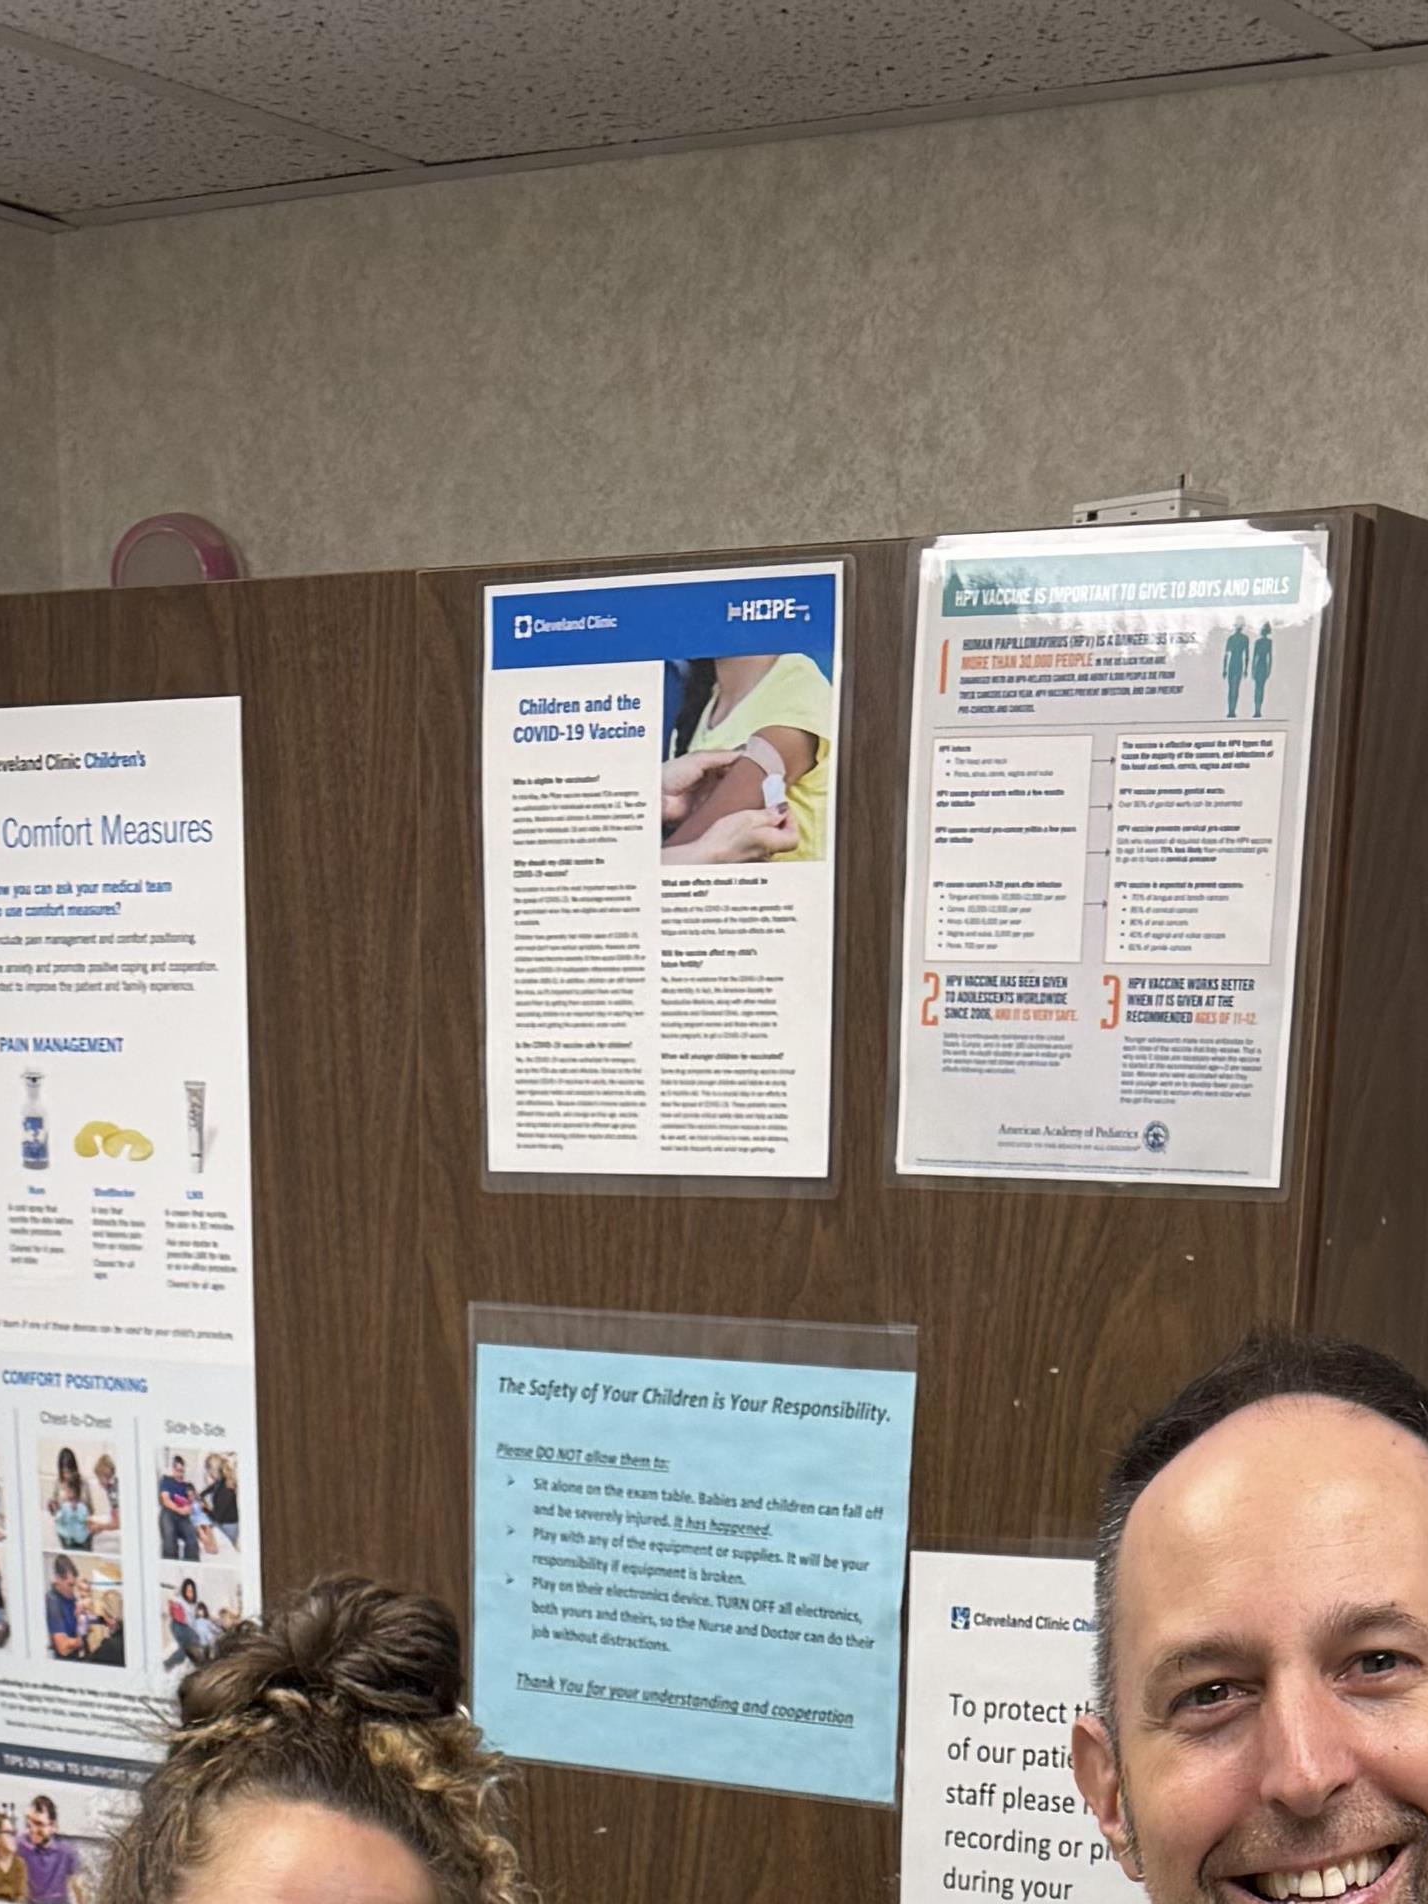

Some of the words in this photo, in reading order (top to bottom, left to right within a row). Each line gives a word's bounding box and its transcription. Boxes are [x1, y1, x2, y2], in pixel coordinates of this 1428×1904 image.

[954, 588, 980, 606] HPV
[981, 587, 1031, 605] VACCINE
[1033, 587, 1046, 604] IS
[1049, 584, 1117, 603] IMPORTANT
[1121, 583, 1135, 600] TO
[1138, 582, 1167, 599] GIVE
[1170, 581, 1185, 598] TO
[1188, 580, 1220, 597] BOYS
[1223, 578, 1249, 595] AND
[1253, 576, 1288, 595] GIRLS
[533, 617, 585, 632] Cleveland
[586, 615, 617, 629] Clinic
[518, 697, 580, 715] Children
[584, 694, 612, 712] and
[616, 694, 640, 710] the
[513, 723, 584, 742] COVID-19
[588, 721, 645, 739] Vaccine
[45, 753, 81, 770] Clinic
[83, 751, 145, 768] Children's
[2, 817, 92, 847] Comfort
[101, 815, 212, 844] Measures
[1127, 977, 1146, 989] HPV
[1148, 977, 1185, 989] VACCINE
[1187, 978, 1218, 990] WORKS
[1220, 978, 1254, 991] BETTER
[921, 972, 940, 1026] 2
[1100, 975, 1120, 1029] 3
[1126, 1010, 1192, 1023] RECOMMENDED
[0, 1036, 29, 1051] PAIN
[32, 1037, 123, 1052] MANAGEMENT
[2, 1369, 61, 1386] COMFORT
[65, 1373, 147, 1392] POSITIONING
[499, 1376, 525, 1394] The
[528, 1379, 577, 1402] Safety
[580, 1382, 599, 1404] of
[602, 1384, 638, 1402] Your
[642, 1387, 708, 1407] Children
[712, 1391, 725, 1409] is
[730, 1393, 768, 1412] Your
[771, 1397, 892, 1425] Responsibility.
[39, 1411, 112, 1428] Chest-to-Chest
[164, 1419, 226, 1437] Side-to-Side
[496, 1442, 534, 1460] Please
[534, 1445, 555, 1461] DO
[555, 1447, 583, 1463] NOT
[584, 1450, 617, 1464] allow
[619, 1453, 650, 1467] them
[653, 1456, 669, 1469] to:
[533, 1477, 548, 1491] Sit
[550, 1479, 583, 1494] alone
[585, 1484, 601, 1495] on
[603, 1483, 624, 1498] the
[626, 1488, 658, 1500] exam
[660, 1489, 695, 1504] table.
[698, 1491, 737, 1507] Babies
[739, 1496, 763, 1509] and
[765, 1498, 815, 1513] children
[817, 1504, 839, 1516] can
[842, 1503, 862, 1518] fall
[864, 1506, 883, 1519] off
[532, 1526, 557, 1543] Play
[559, 1530, 585, 1543] with
[587, 1535, 609, 1549] any
[611, 1533, 624, 1548] of
[626, 1535, 646, 1550] the
[648, 1539, 712, 1556] equipment
[715, 1546, 729, 1557] or
[731, 1547, 783, 1563] supplies.
[786, 1551, 796, 1565] It
[798, 1553, 820, 1566] will
[823, 1554, 839, 1569] be
[840, 1559, 869, 1572] your
[973, 1612, 1033, 1630] Cleveland
[1035, 1615, 1070, 1631] Clinic
[516, 1672, 557, 1693] Thank
[557, 1677, 584, 1696] You
[583, 1679, 607, 1699] for
[607, 1686, 641, 1702] your
[641, 1690, 739, 1713] understanding
[741, 1700, 769, 1716] and
[771, 1705, 853, 1724] cooperation
[949, 1693, 976, 1718] To
[984, 1699, 1068, 1725] protect
[947, 1736, 972, 1761] of
[976, 1744, 1016, 1764] our
[945, 1782, 997, 1807] staff
[1002, 1786, 1076, 1814] please
[944, 1829, 1052, 1861] recording
[1058, 1840, 1083, 1858] or
[943, 1866, 1014, 1900] during
[1020, 1879, 1073, 1902] your
